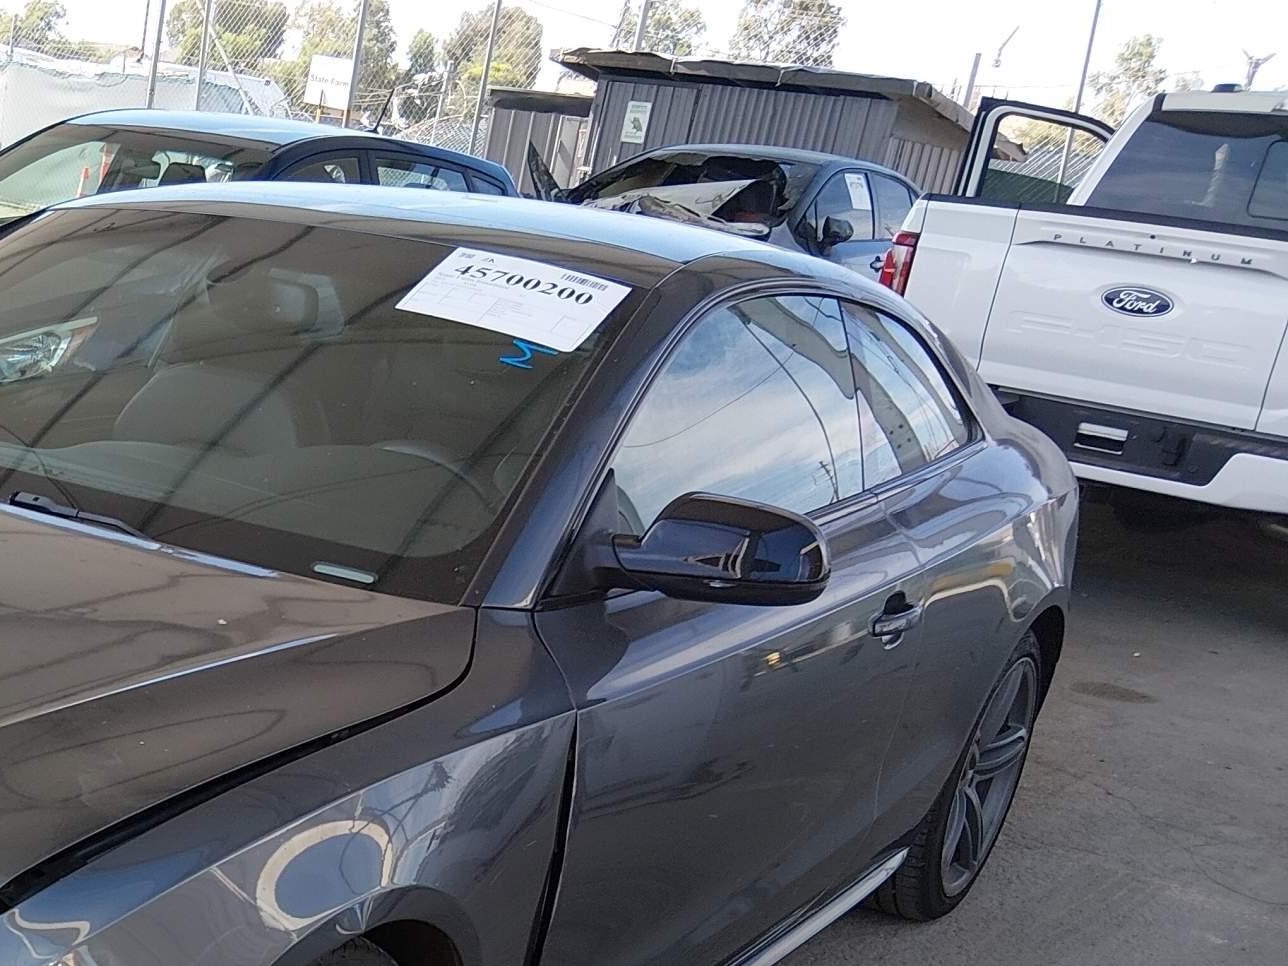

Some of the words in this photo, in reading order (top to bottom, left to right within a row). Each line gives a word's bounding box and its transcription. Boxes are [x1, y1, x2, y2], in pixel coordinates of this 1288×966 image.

[310, 74, 329, 84] State
[330, 78, 349, 88] Farm
[1053, 233, 1254, 266] PLATINUM
[454, 264, 594, 305] 45700200
[1112, 287, 1158, 314] Ford
